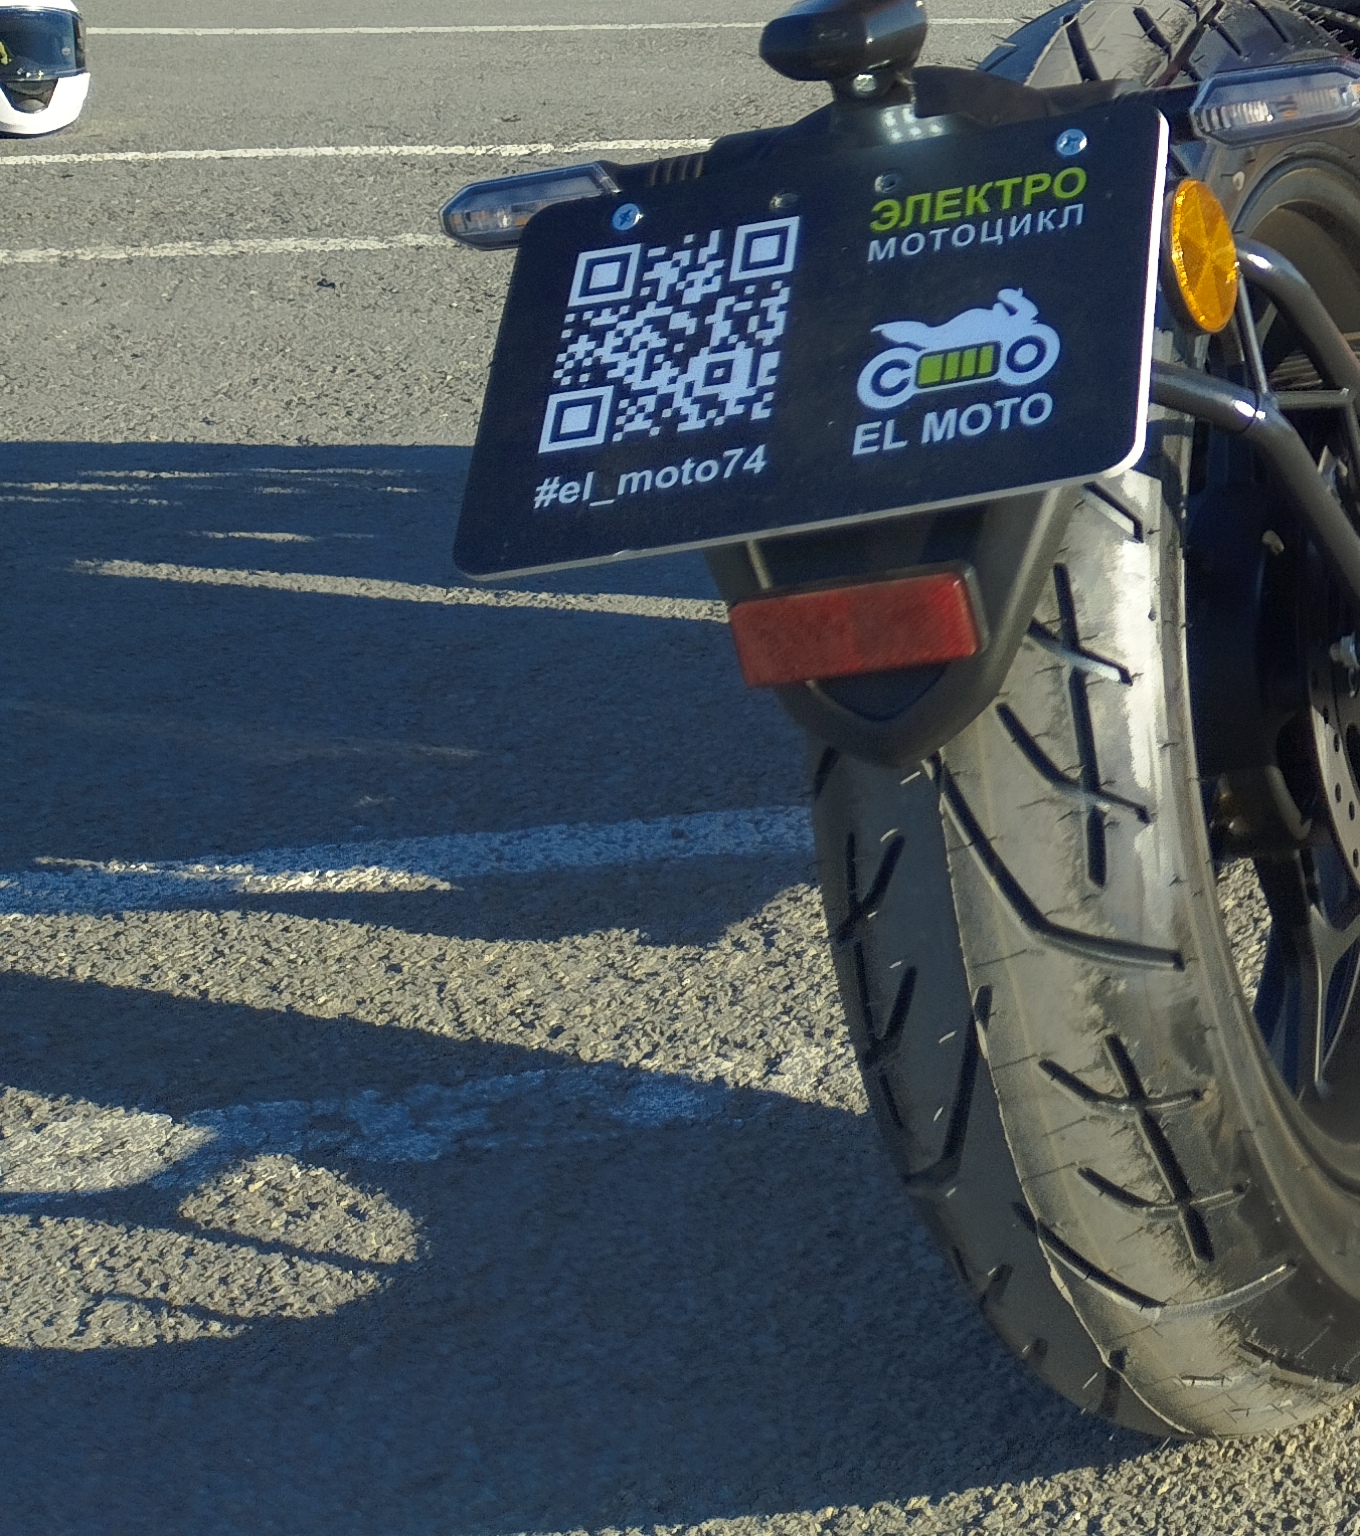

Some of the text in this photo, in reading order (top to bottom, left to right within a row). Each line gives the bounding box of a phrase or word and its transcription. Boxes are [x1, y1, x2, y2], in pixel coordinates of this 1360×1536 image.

[870, 166, 1088, 232] ЭЛЕКТРО
[866, 202, 1085, 263] МОТОЦИКЛ
[852, 392, 1054, 457] EL MOTO
[533, 443, 768, 510] #el_moto74
